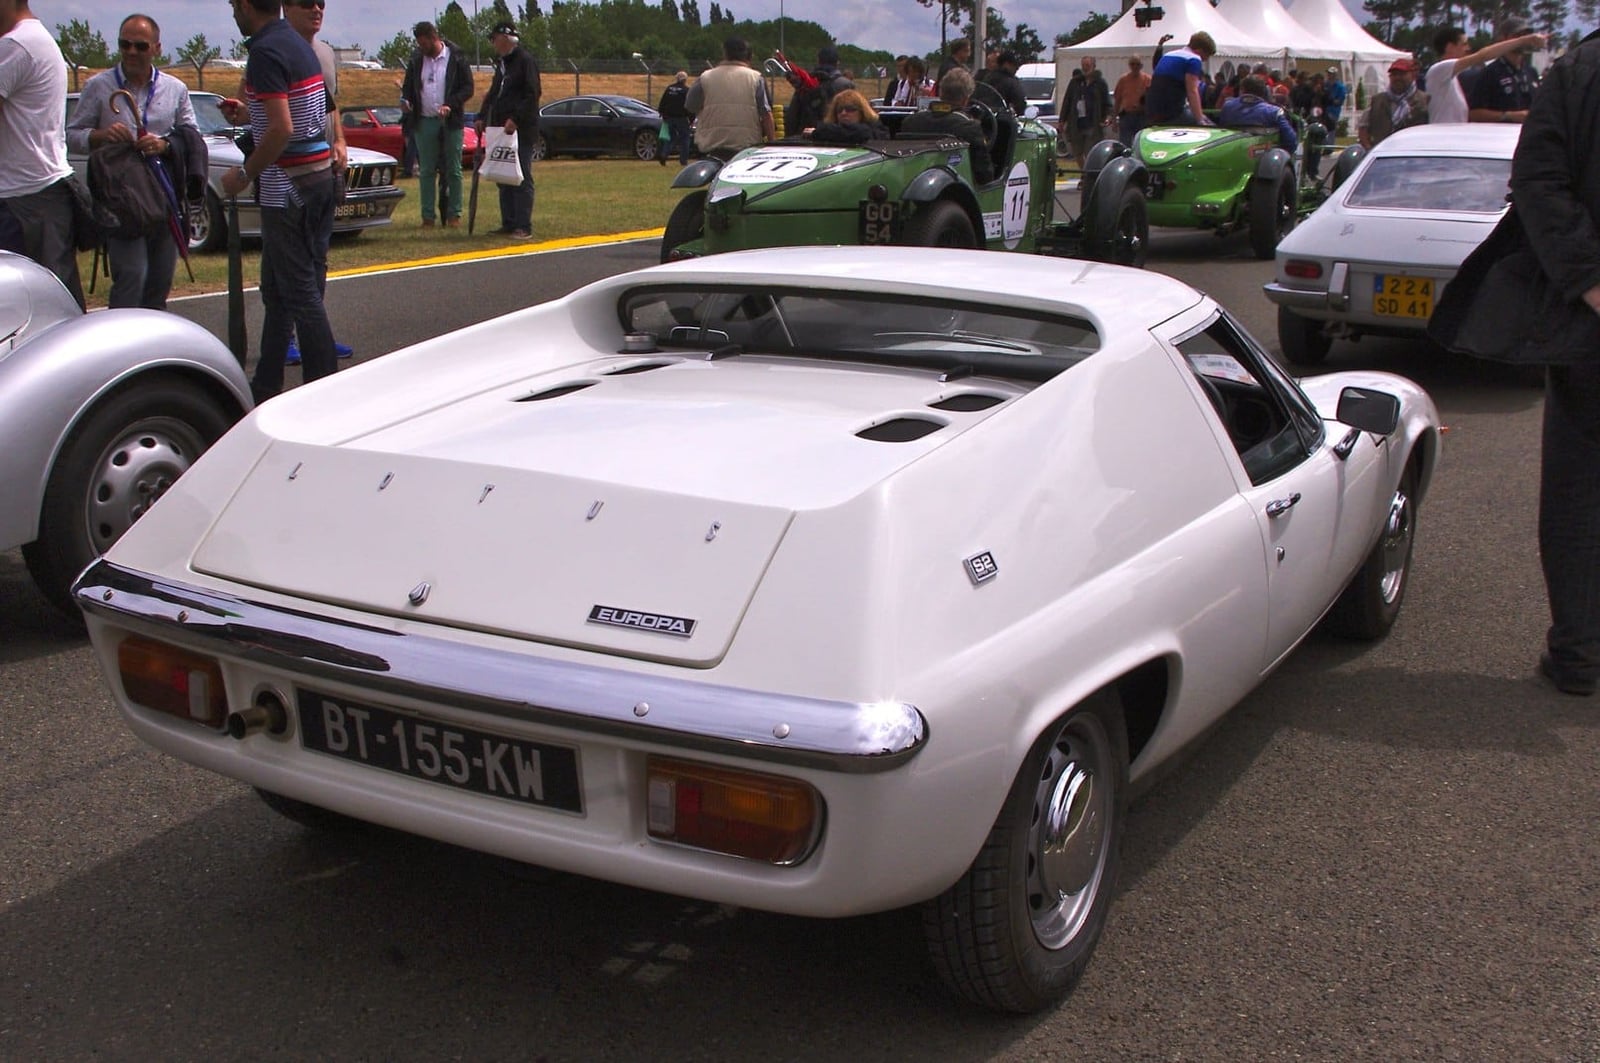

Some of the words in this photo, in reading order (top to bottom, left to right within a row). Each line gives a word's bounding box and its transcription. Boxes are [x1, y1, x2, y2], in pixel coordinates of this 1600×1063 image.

[746, 160, 794, 172] 11
[866, 203, 893, 222] GO
[1011, 190, 1025, 222] 11
[1391, 278, 1431, 297] 224
[1378, 298, 1399, 315] SD
[1408, 300, 1428, 317] 41
[972, 554, 994, 573] S2
[597, 608, 686, 633] EUROPA
[322, 700, 544, 800] BT-155-KW
